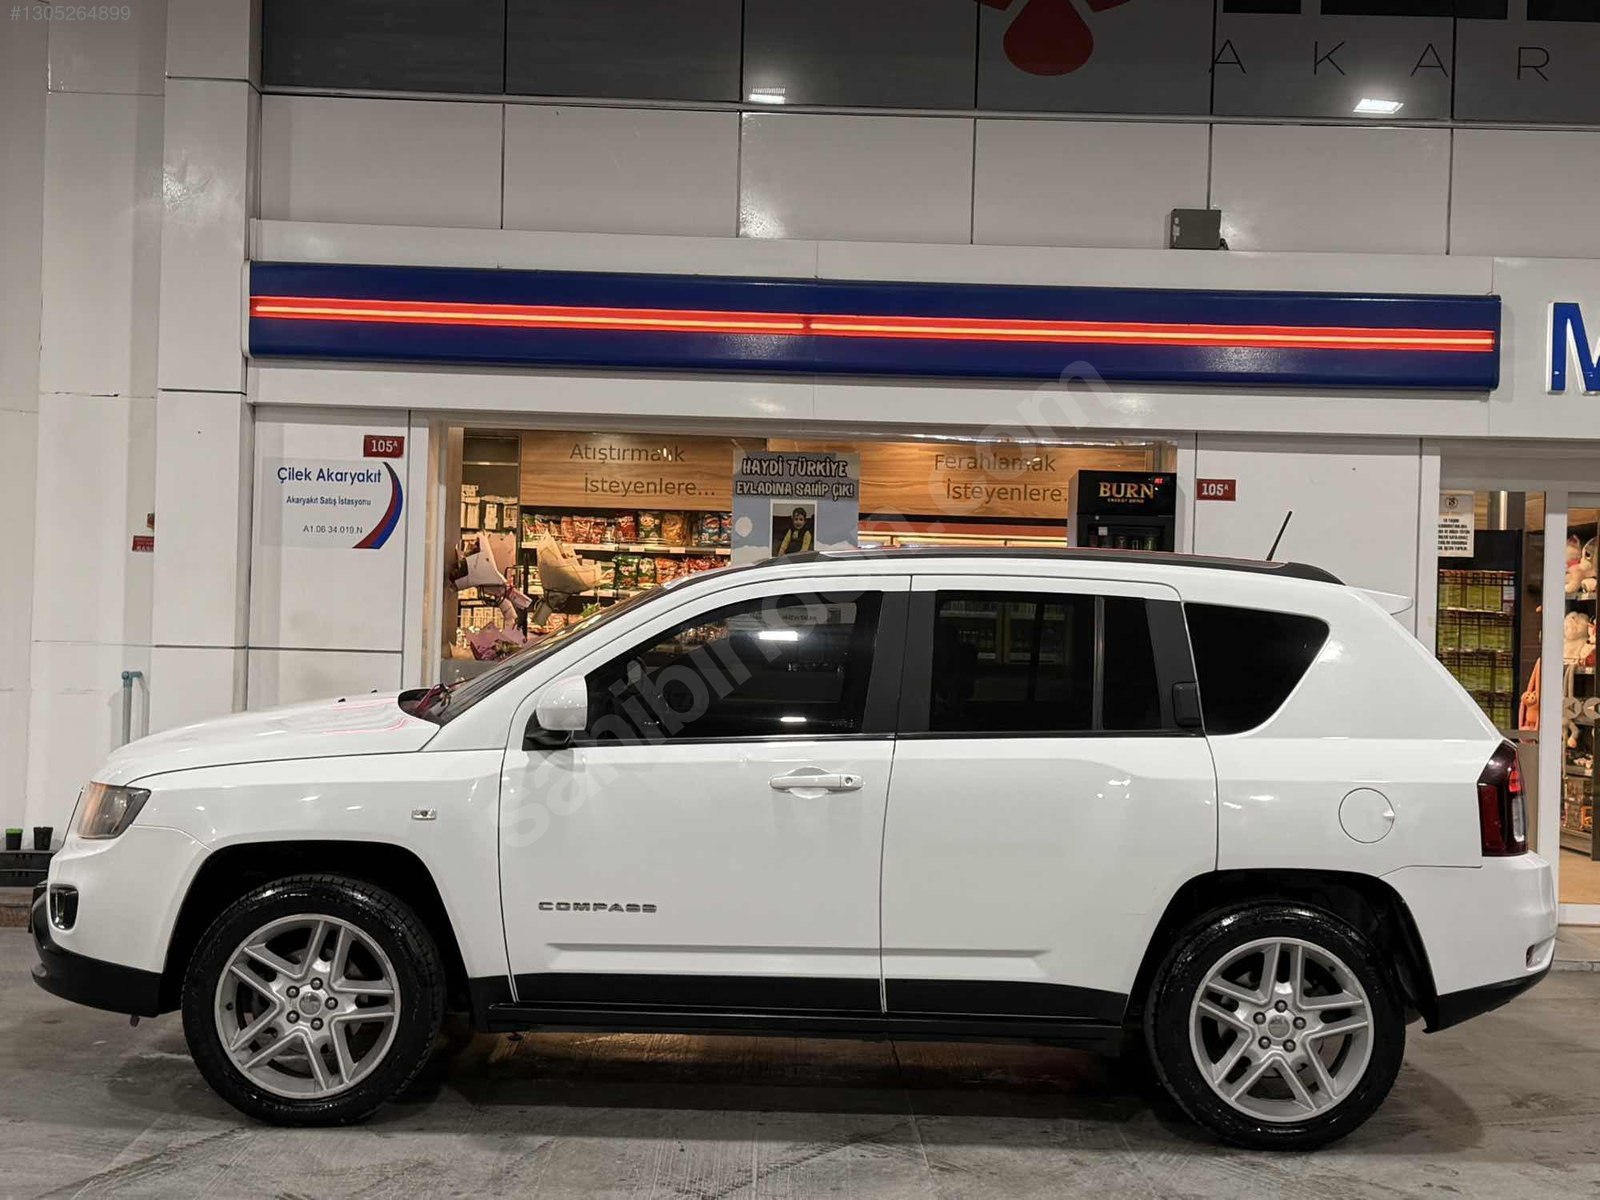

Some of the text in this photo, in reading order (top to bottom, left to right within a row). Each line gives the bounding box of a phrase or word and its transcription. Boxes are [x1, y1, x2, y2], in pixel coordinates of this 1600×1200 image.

[742, 455, 848, 478] HAYDİ TÜRKİYE
[935, 453, 1056, 473] Ferahlamak
[277, 467, 382, 485] Çilek Akaryakıt
[795, 480, 829, 497] SAHİP
[832, 482, 855, 502] ÇIK!
[1099, 482, 1154, 499] BURN
[538, 902, 657, 913] COMPASS
